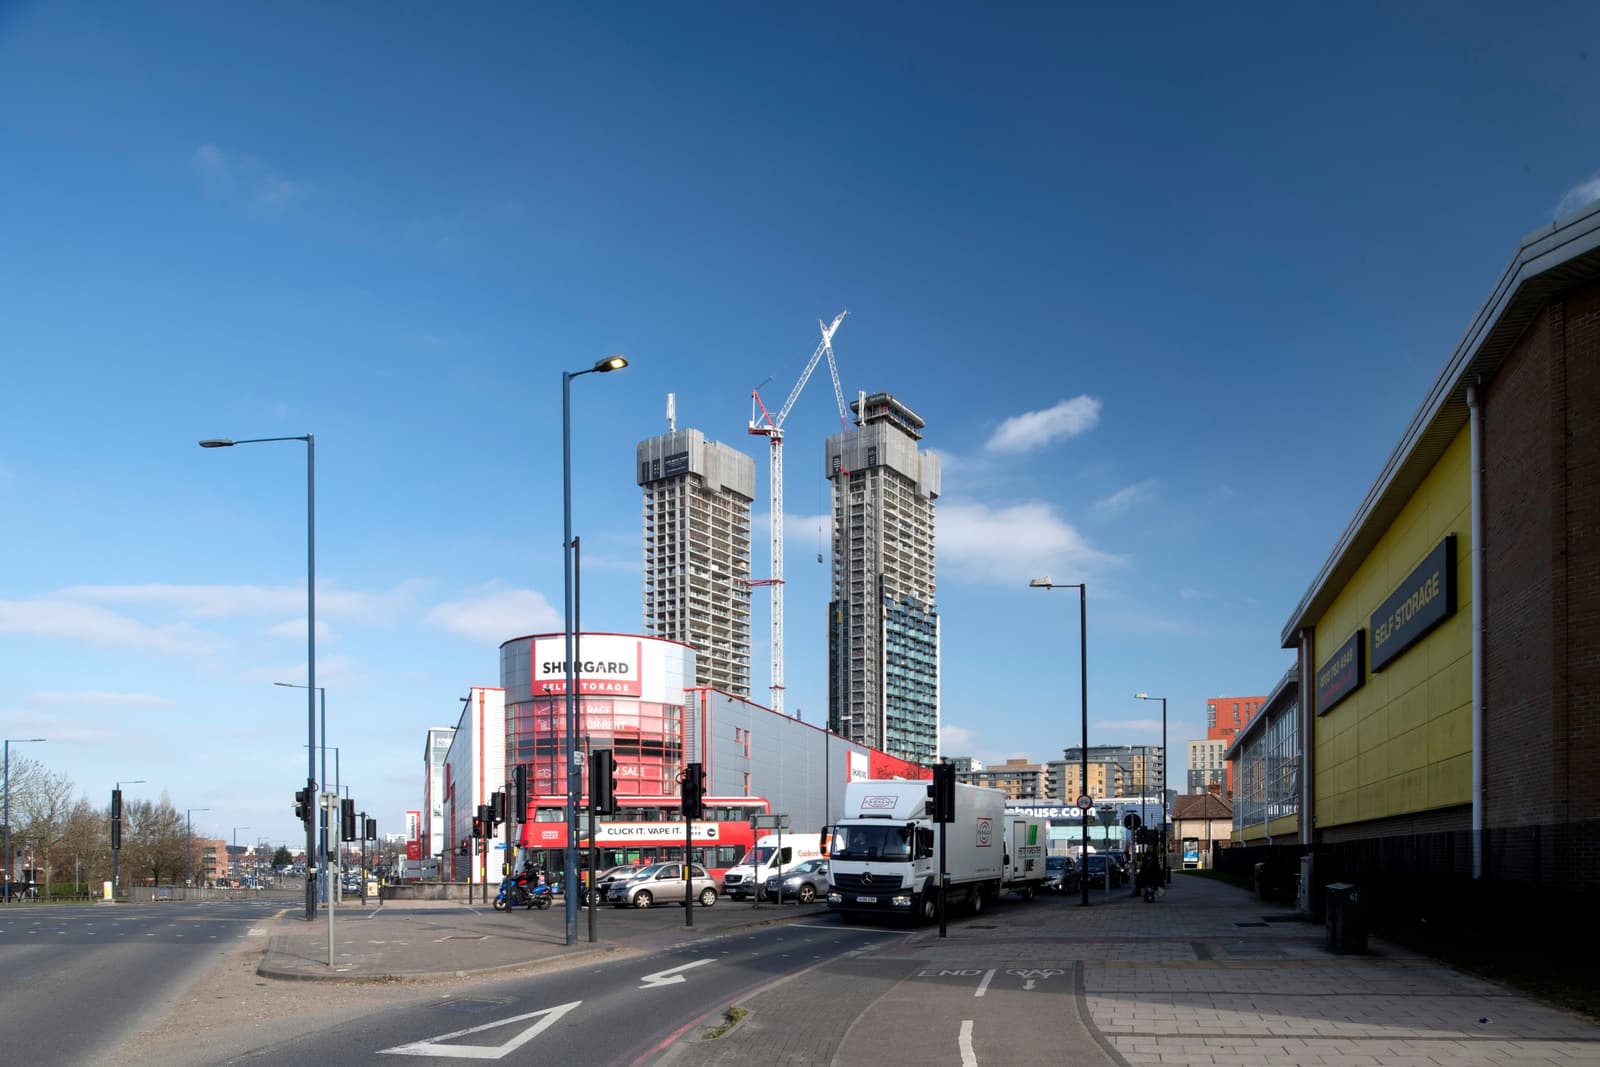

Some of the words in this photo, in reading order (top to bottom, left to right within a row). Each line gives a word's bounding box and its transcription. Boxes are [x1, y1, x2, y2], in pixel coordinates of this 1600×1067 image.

[1375, 614, 1394, 649] SELF
[1395, 570, 1440, 631] STORAGE
[581, 682, 630, 692] TORAGE
[607, 827, 634, 836] CLICK
[635, 827, 646, 835] IT.
[647, 827, 670, 835] VAPE
[671, 827, 682, 835] IT.
